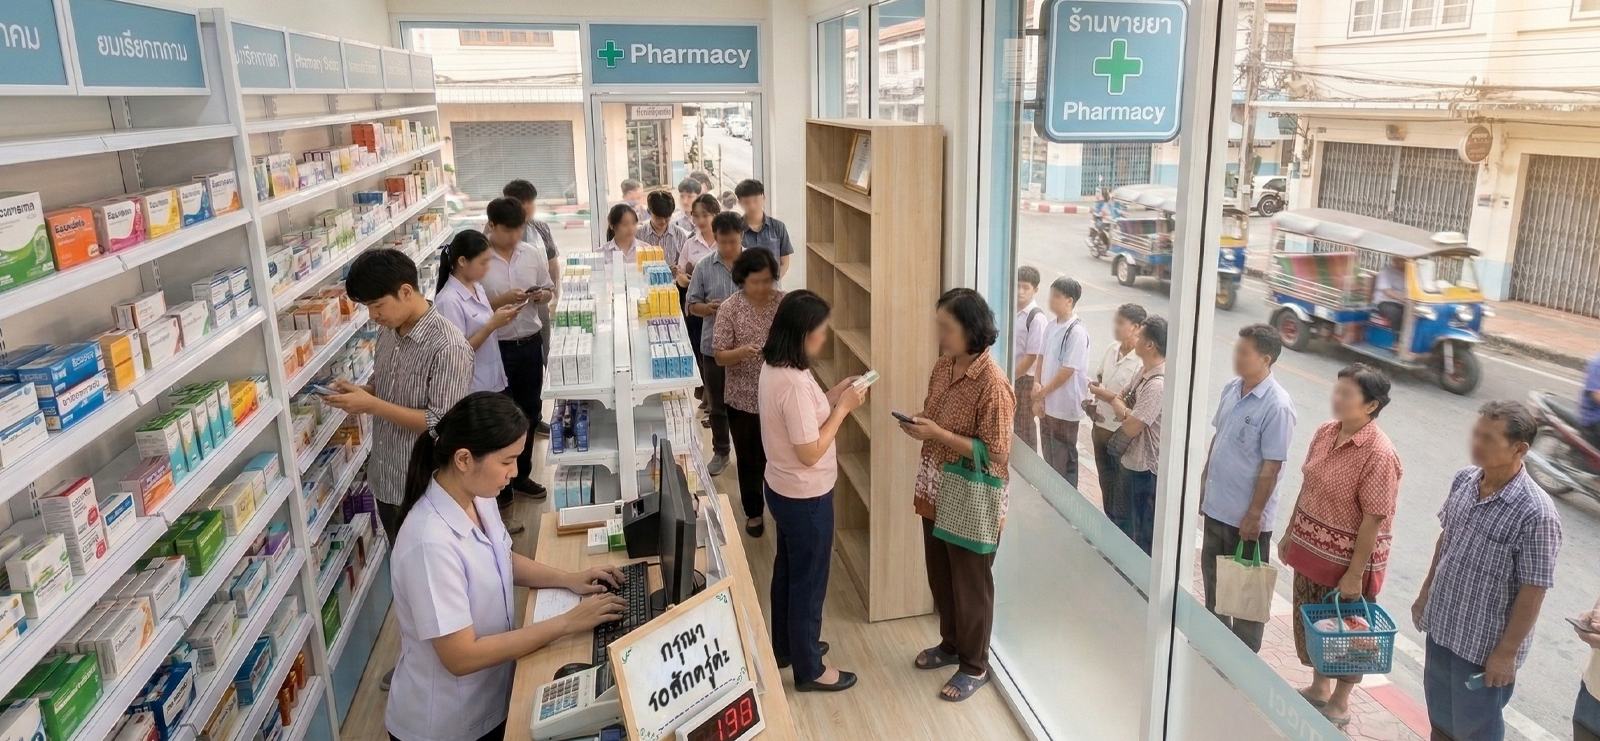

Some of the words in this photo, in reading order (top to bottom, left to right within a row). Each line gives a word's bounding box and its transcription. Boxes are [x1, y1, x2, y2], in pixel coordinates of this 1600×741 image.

[1068, 7, 1172, 35] ร้านขายยา
[630, 43, 751, 69] Pharmacy
[1063, 101, 1166, 125] Pharmacy
[660, 623, 705, 666] กรุณา
[717, 697, 753, 741] 198
